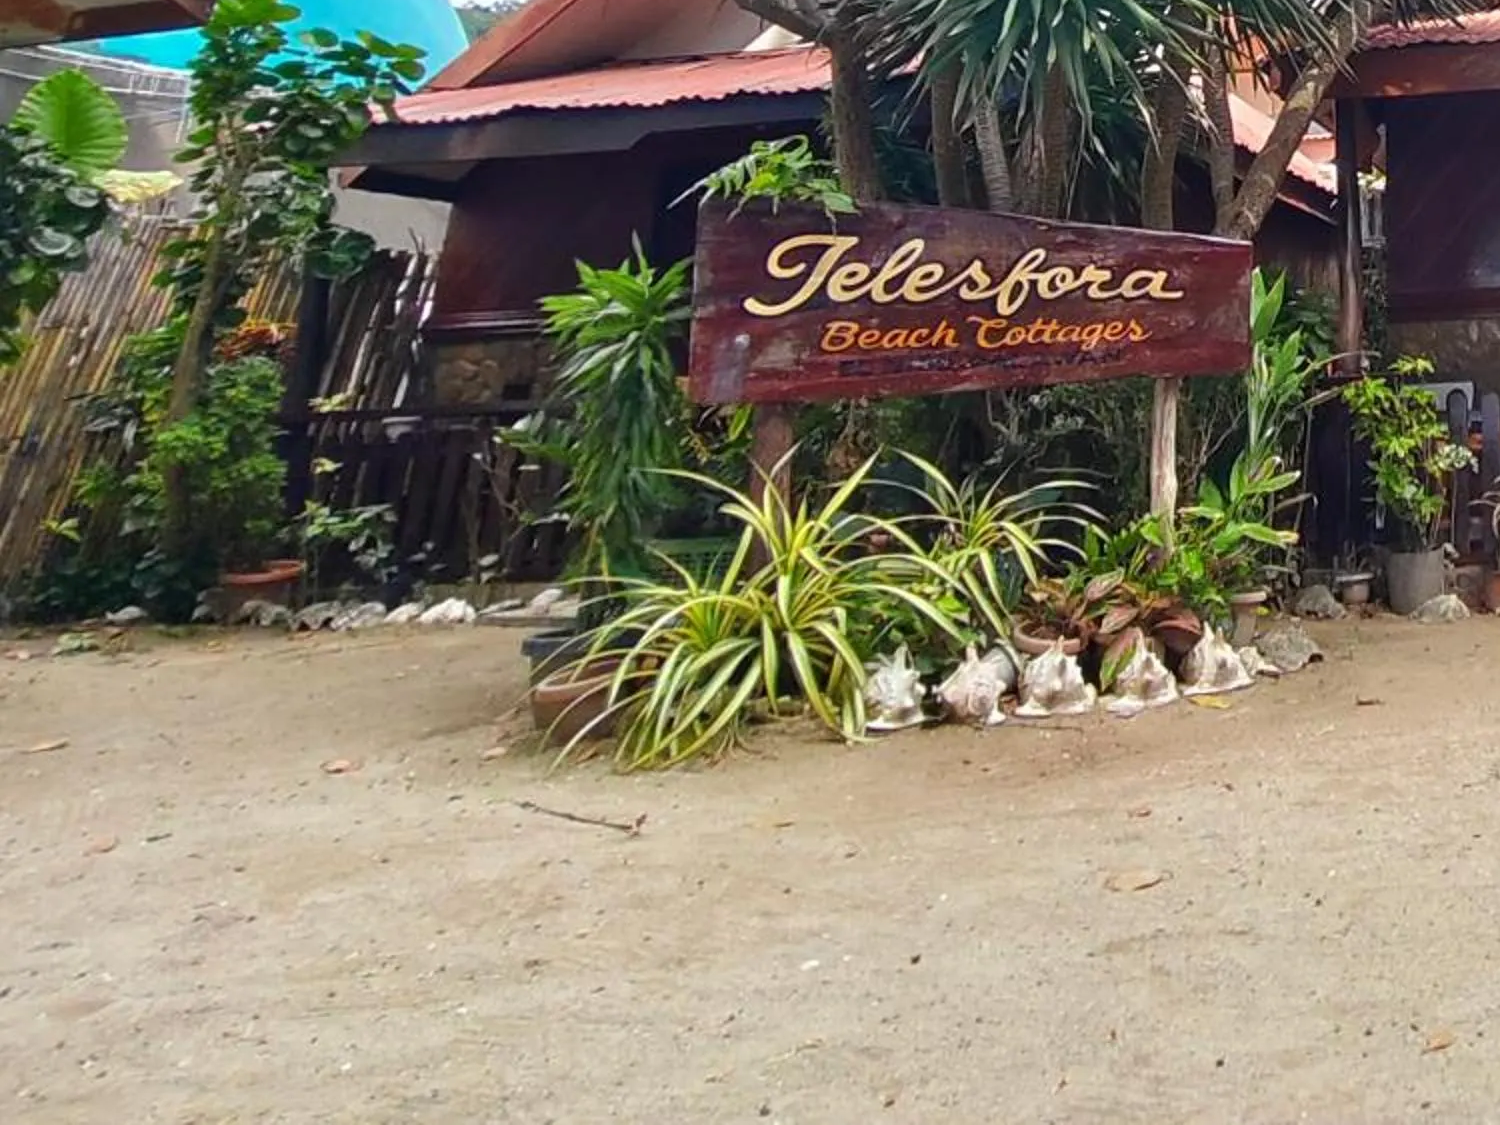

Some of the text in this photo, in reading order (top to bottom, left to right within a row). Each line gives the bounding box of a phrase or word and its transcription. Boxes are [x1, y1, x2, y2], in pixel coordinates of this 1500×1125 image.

[743, 234, 1184, 317] Telesfora
[820, 314, 1153, 353] Beach Cottages
